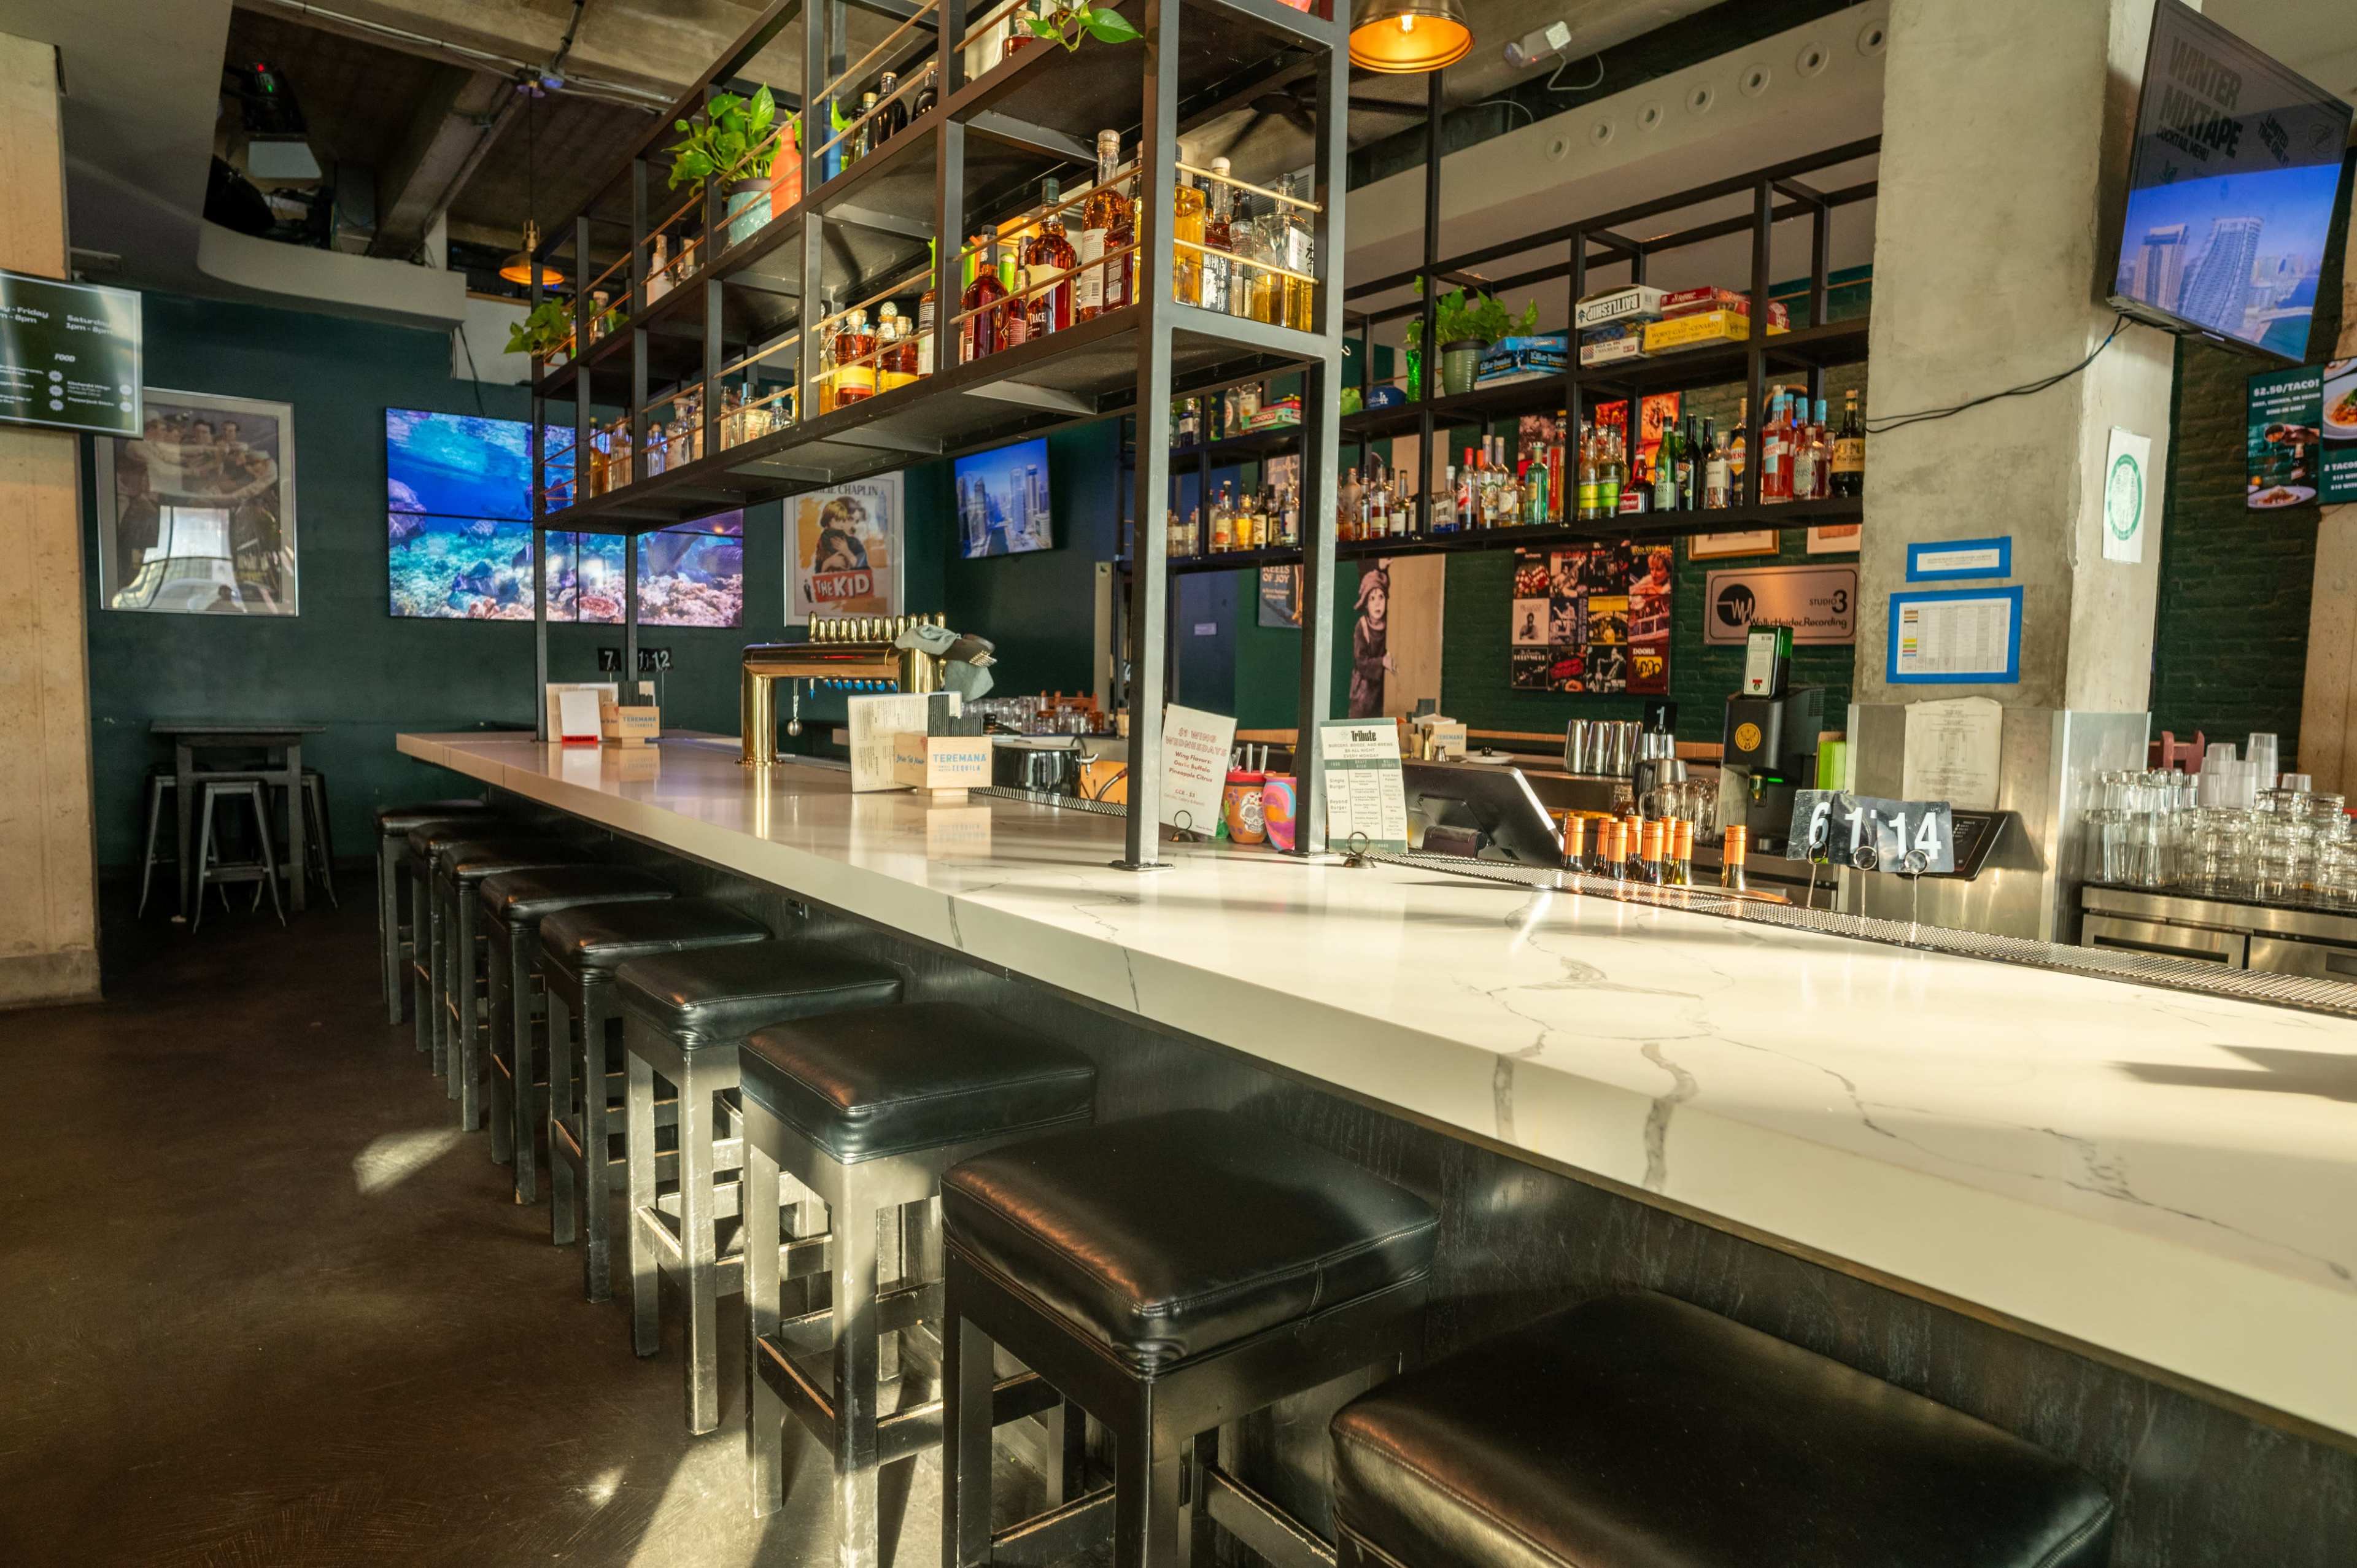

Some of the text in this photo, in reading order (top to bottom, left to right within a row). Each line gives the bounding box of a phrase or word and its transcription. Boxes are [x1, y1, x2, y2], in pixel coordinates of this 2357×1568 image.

[2169, 36, 2242, 111] WINTER
[2159, 83, 2243, 159] MIXTAPE
[2189, 141, 2210, 162] MENU
[17, 307, 48, 319] Friday
[1587, 293, 1640, 321] BATTLESHIP
[1029, 311, 1046, 325] TRACE
[55, 353, 75, 362] FOOD
[2253, 379, 2320, 397] $2.50/TACO!
[838, 485, 879, 496] CHAPLIN
[815, 573, 871, 597] THE KID
[1263, 573, 1290, 583] OF JOY
[1809, 589, 1848, 614] STUDIO 3
[1803, 616, 1848, 630] Recording
[605, 651, 614, 668] 7
[652, 651, 670, 670] 12
[1657, 706, 1665, 730] 1
[1178, 727, 1217, 744] $1 WING
[1351, 730, 1377, 742] Tribute
[1165, 735, 1228, 757] WEDNESDAYS
[932, 753, 987, 763] TEREMANA
[1174, 760, 1210, 773] Garlic Buffalo
[1175, 751, 1212, 765] Wing Flavors:
[1169, 767, 1213, 782] Pineapple Citrus
[1808, 801, 1832, 849] 6
[1889, 811, 1942, 860] 14
